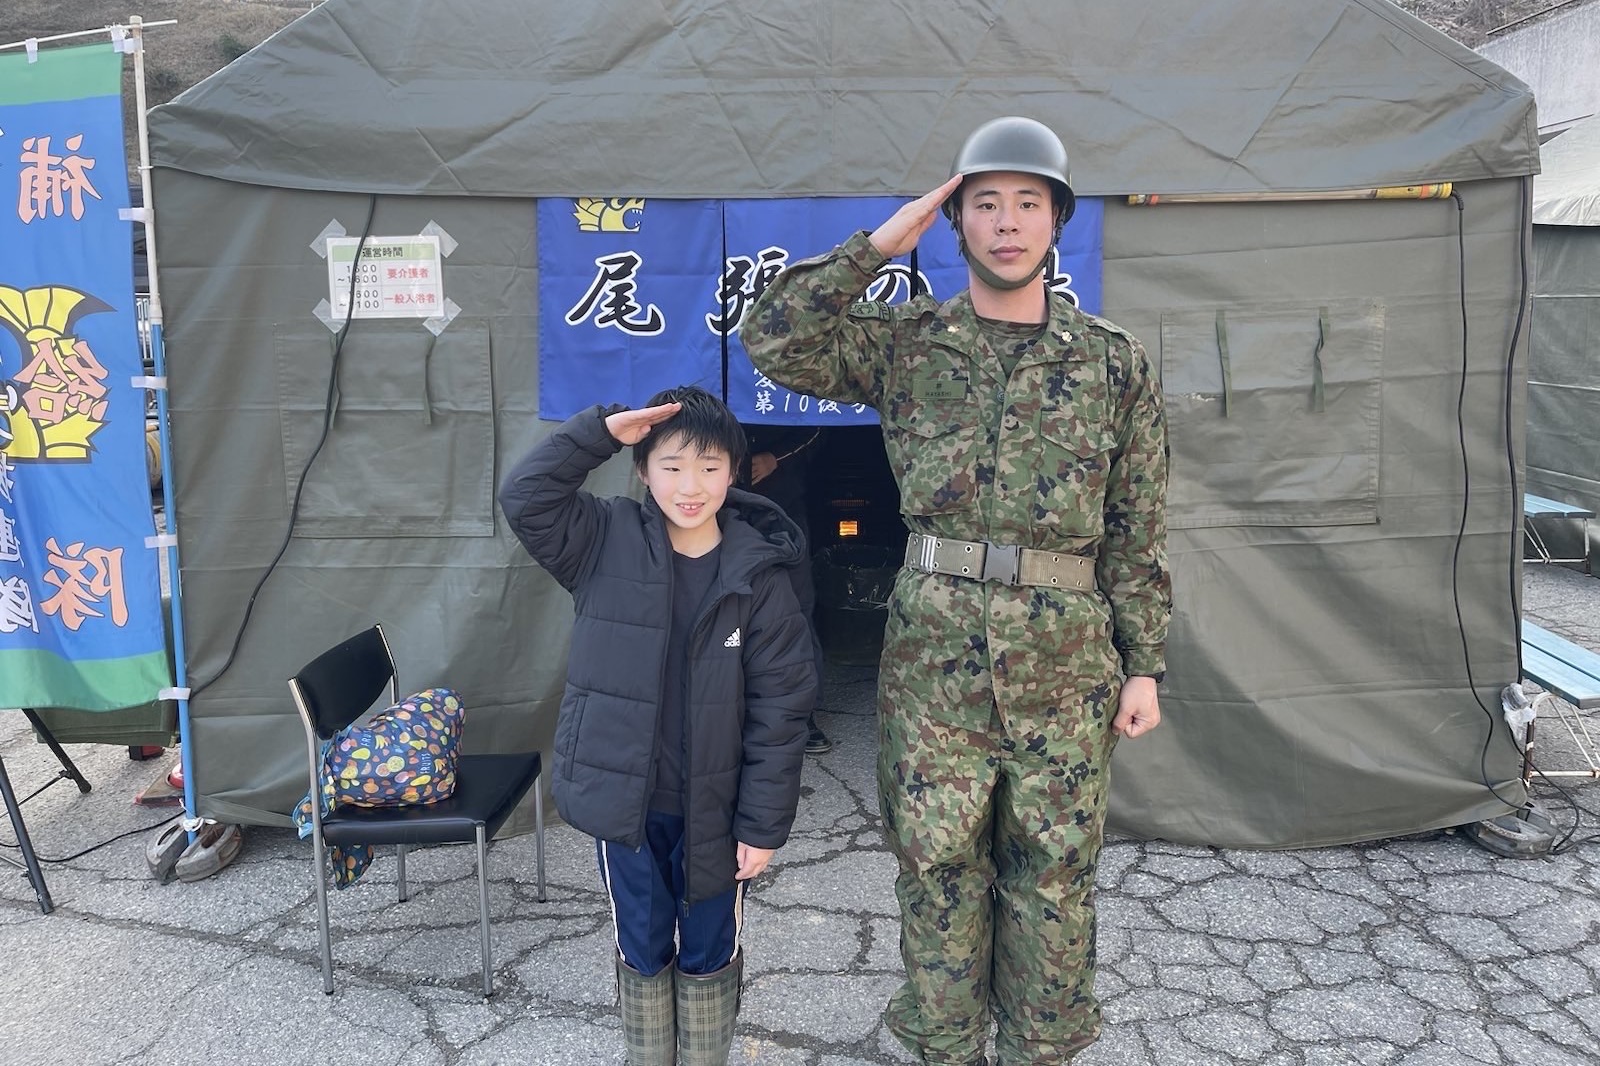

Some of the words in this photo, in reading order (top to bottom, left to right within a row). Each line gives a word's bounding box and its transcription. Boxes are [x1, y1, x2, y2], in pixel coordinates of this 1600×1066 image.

[361, 246, 404, 258] 運営時間
[386, 268, 429, 279] 要介護者
[349, 289, 379, 299] 600
[384, 293, 436, 305] 一般入浴者
